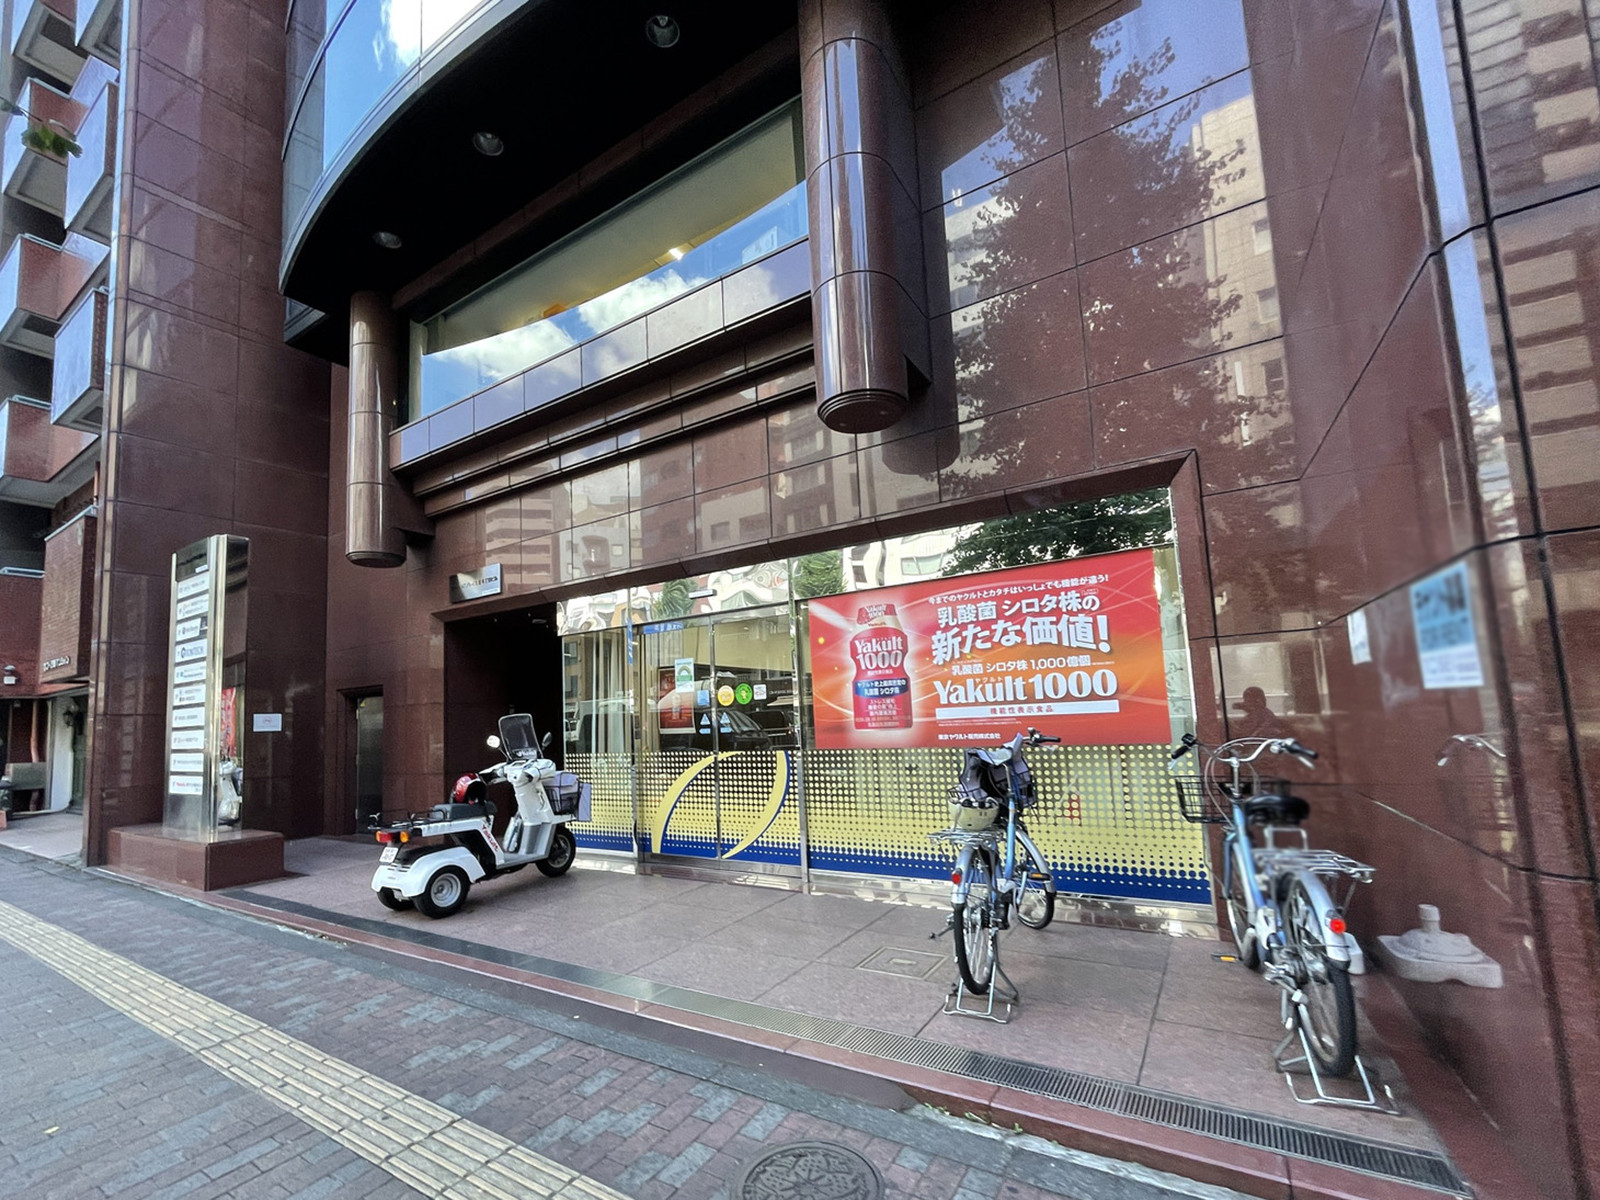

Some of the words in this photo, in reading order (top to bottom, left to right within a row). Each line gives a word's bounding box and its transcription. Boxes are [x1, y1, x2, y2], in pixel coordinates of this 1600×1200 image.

[937, 601, 997, 628] 乳酸菌
[1001, 590, 1101, 616] シロタ株の
[854, 636, 904, 653] Yakult
[855, 650, 903, 670] 1000
[986, 659, 1029, 673] シロタ株
[933, 675, 1028, 705] Yakult
[1028, 669, 1118, 700] 1000
